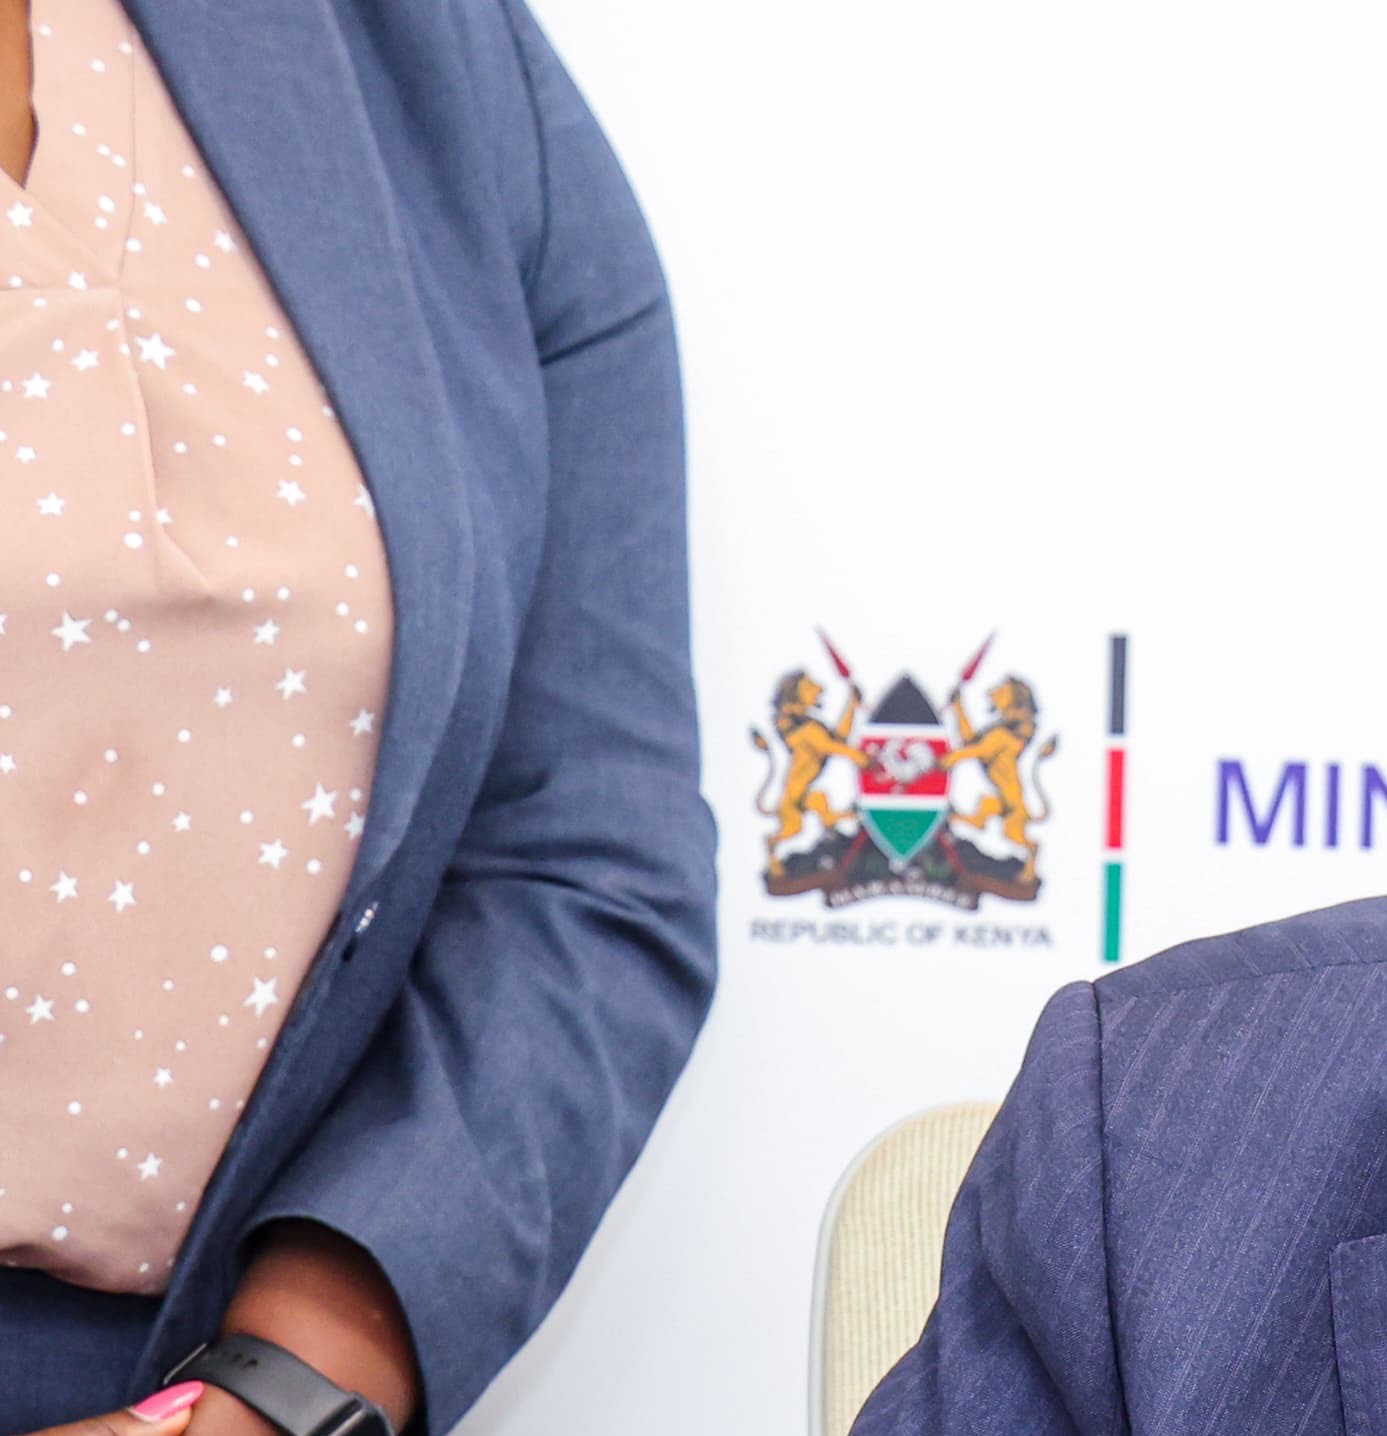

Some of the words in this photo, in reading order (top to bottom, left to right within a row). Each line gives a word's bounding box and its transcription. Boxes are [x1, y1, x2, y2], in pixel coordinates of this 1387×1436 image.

[748, 916, 897, 946] REPUBLIC
[905, 921, 945, 946] OF
[952, 922, 1055, 949] KENYA
